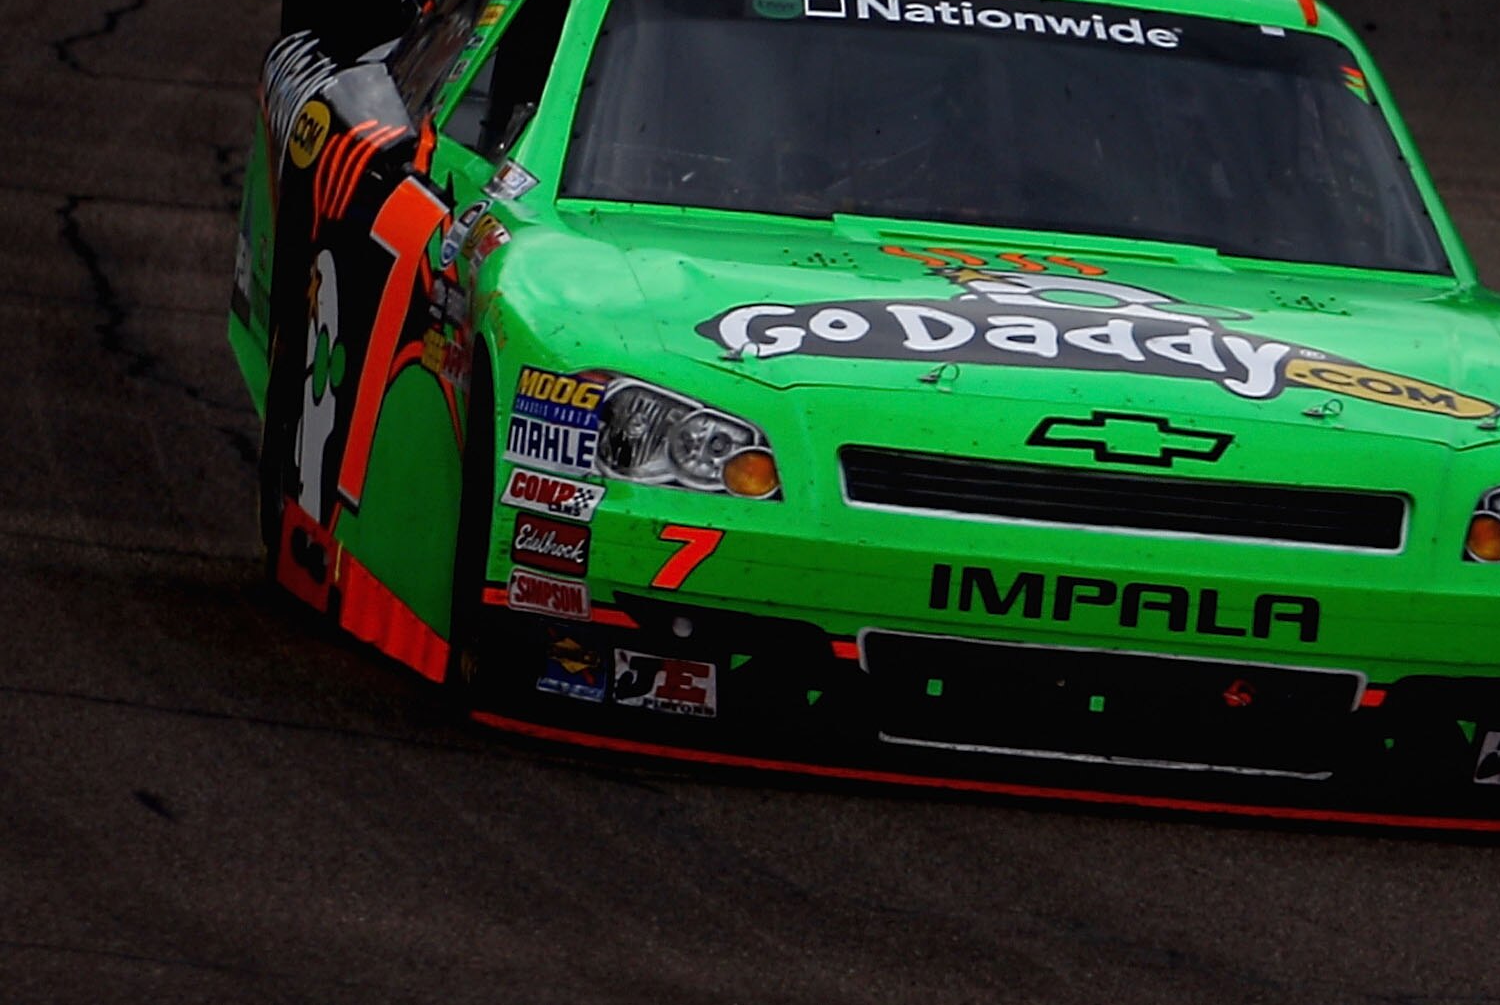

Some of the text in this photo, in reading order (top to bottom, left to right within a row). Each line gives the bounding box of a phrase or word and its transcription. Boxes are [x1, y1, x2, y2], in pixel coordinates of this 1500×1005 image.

[336, 177, 449, 511] 7
[718, 303, 1458, 412] Go Daddy .COM
[519, 368, 606, 411] MOOG
[507, 417, 597, 469] MAHLE
[510, 472, 577, 505] COMP
[514, 523, 586, 563] Edelbrock
[651, 525, 725, 590] 7
[514, 575, 583, 613] SIMPSON
[929, 564, 1320, 642] IMPALA
